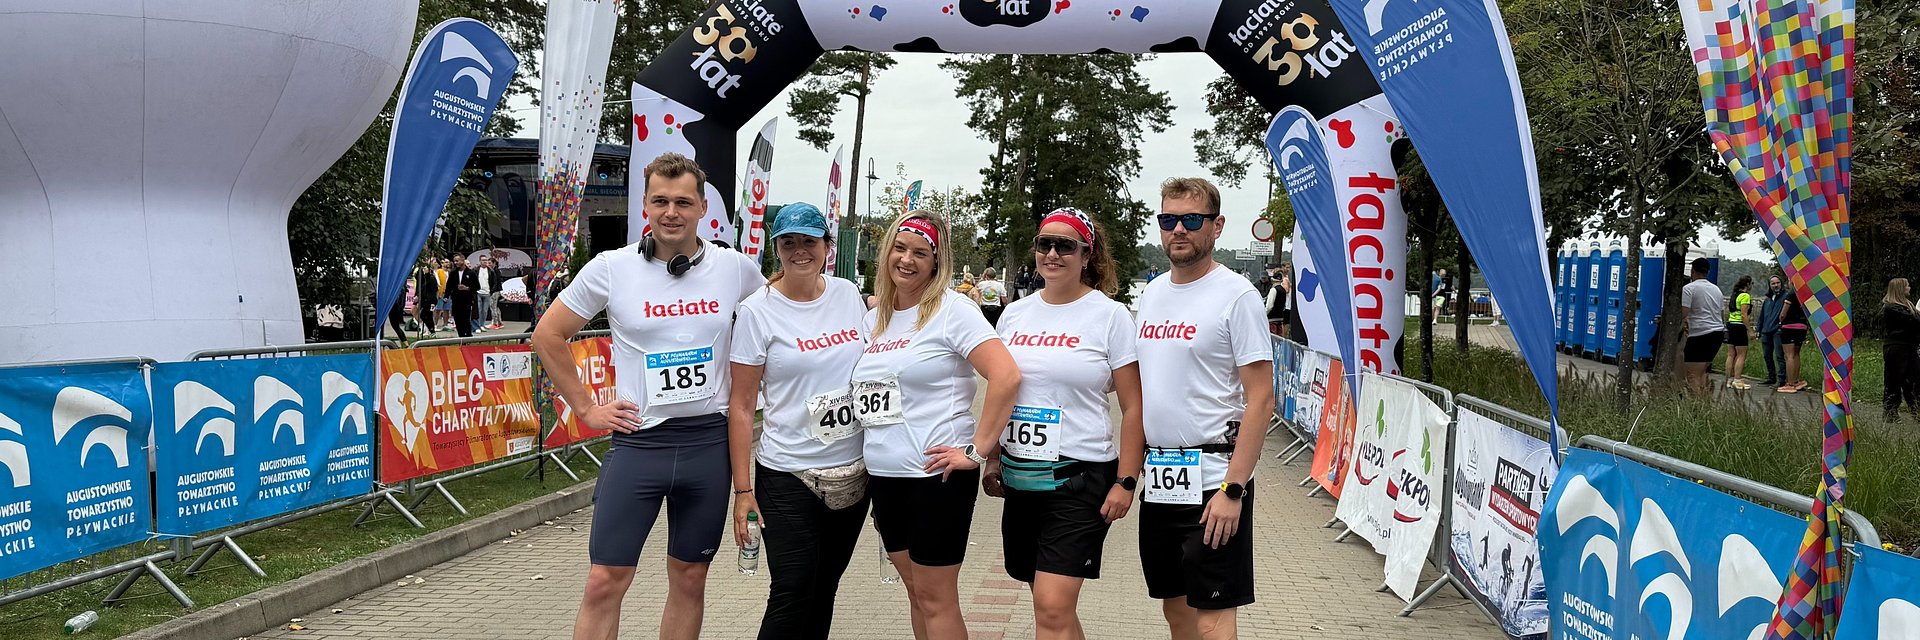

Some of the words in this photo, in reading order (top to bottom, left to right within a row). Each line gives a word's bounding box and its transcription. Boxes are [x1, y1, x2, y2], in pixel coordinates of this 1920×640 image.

[693, 4, 757, 63] 30
[748, 21, 769, 42] ROKU
[1228, 0, 1286, 46] łaciat
[1243, 42, 1254, 53] OD
[1254, 21, 1273, 40] 1995
[1274, 1, 1295, 21] ROKU
[1252, 12, 1320, 86] 30
[432, 99, 484, 123] TOWARZYSTWO
[433, 89, 486, 114] AUGUSTOWSKIE
[430, 109, 482, 133] PŁYWACKIE
[1346, 172, 1397, 375] łaciate
[643, 298, 719, 318] łaciate
[796, 328, 860, 352] łaciate
[1008, 331, 1080, 348] łaciate
[1139, 319, 1197, 341] łaciate
[432, 367, 484, 407] BIEG
[659, 364, 707, 391] 185
[859, 391, 890, 414] 361
[432, 401, 535, 435] CHARYTATYWNY
[1007, 421, 1048, 447] 165
[259, 454, 307, 472] AUGUSTOWSKIE
[327, 443, 369, 460] AUGUSTOWSKIE
[177, 466, 235, 486] AUGUSTOWSKIE
[327, 456, 370, 472] TOWARZYSTWO
[259, 467, 311, 486] TOWARZYSTWO
[1151, 466, 1191, 490] 164
[1498, 462, 1530, 502] PARTNER
[66, 479, 132, 504] AUGUSTOWSKIE
[177, 481, 236, 502] TOWARZYSTWO
[258, 480, 311, 501] PŁYWACKIE
[0, 500, 32, 518] WSKIE
[67, 496, 133, 521] TOWARZYSTWO
[178, 495, 239, 517] PŁYWACKIE
[66, 512, 135, 539] PŁYWACKIE
